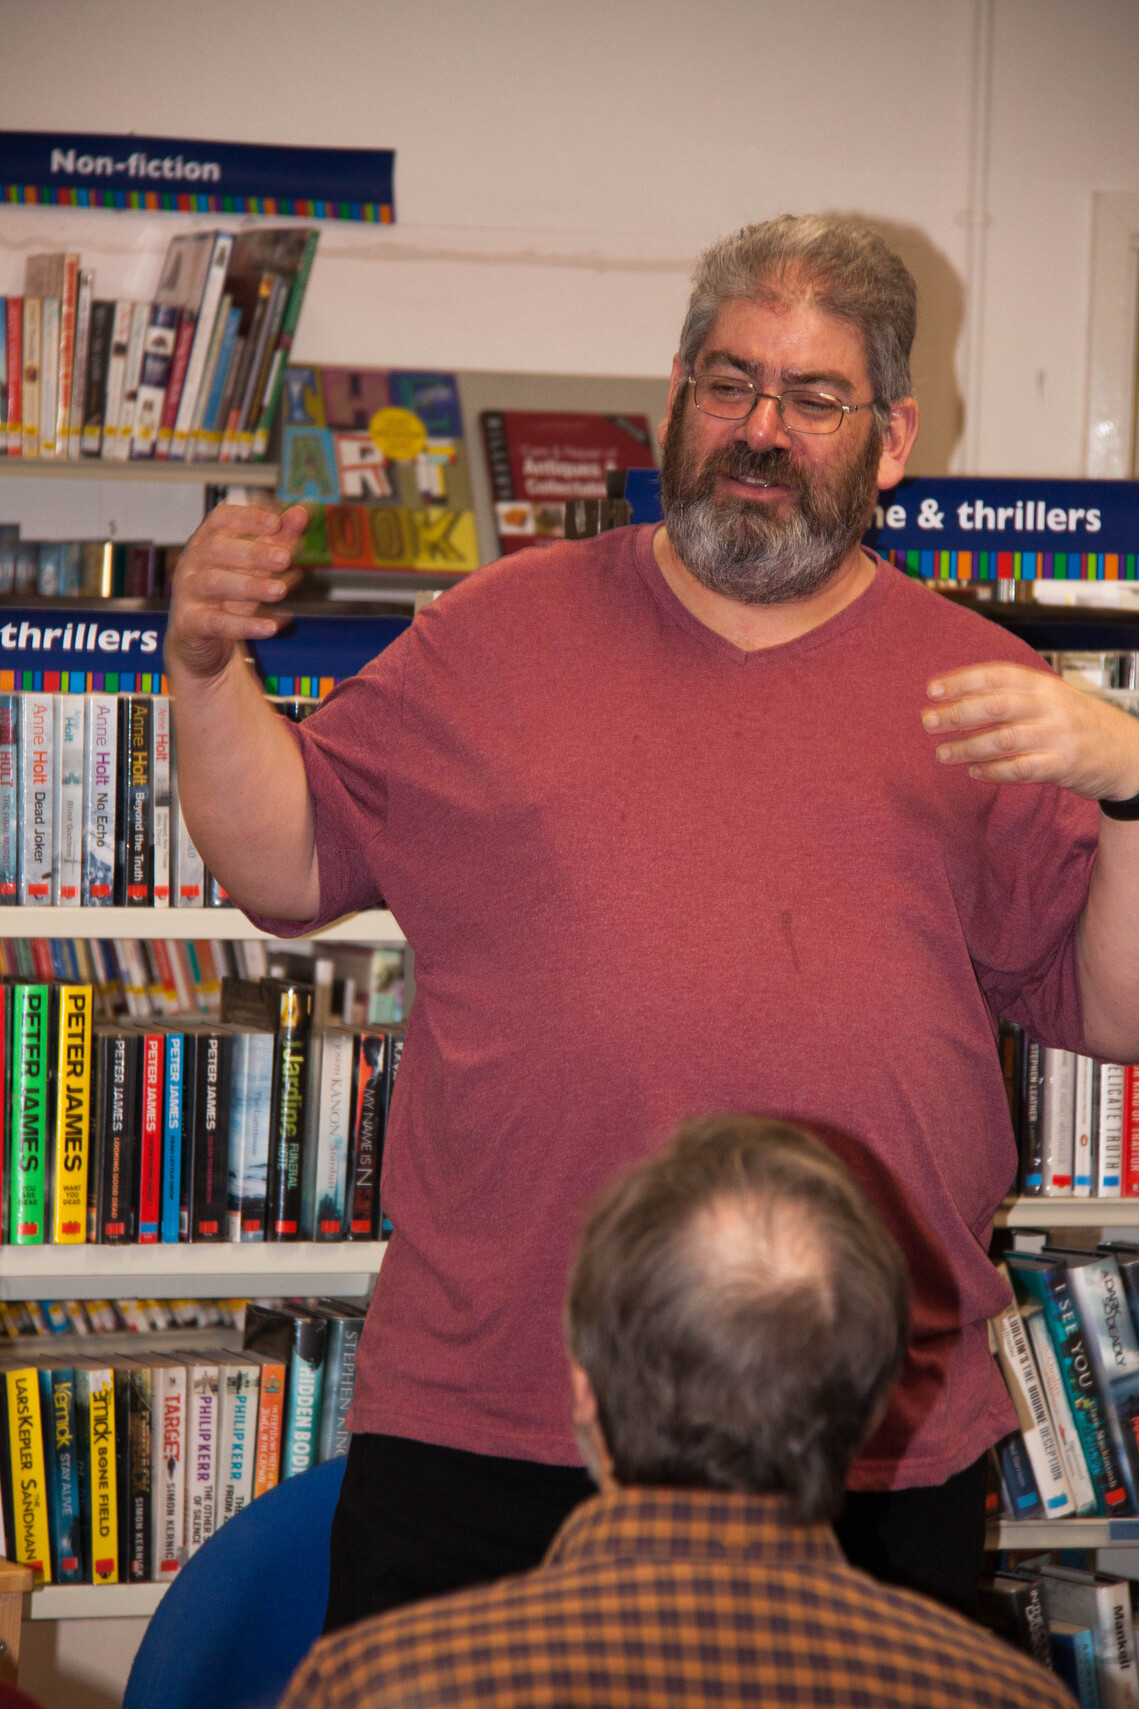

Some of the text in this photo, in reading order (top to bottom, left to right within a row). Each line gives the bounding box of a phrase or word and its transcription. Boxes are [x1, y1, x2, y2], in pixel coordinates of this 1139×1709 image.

[51, 148, 221, 182] Non-fiction
[917, 498, 945, 530] &
[957, 499, 1102, 533] thrillers
[0, 621, 158, 653] thrillers
[33, 704, 48, 785] Anne Holt
[64, 717, 74, 743] Holt
[95, 704, 111, 786] Anne Holt
[132, 704, 148, 786] Anne Holt
[155, 707, 168, 763] Anne Holt
[34, 792, 46, 864] Dead Joker
[65, 824, 73, 858] Goddess
[96, 793, 108, 848] No Echo
[133, 792, 145, 882] Beyond the Truth
[64, 993, 86, 1173] PETER JAMES
[112, 1040, 125, 1132] PETER JAMES
[146, 1040, 158, 1132] PETER JAMES
[169, 1038, 181, 1129] PETER JAMES
[206, 1039, 218, 1130] PETER JAMES
[279, 1048, 304, 1137] Jardine
[1029, 1043, 1039, 1082] STEPHEN
[19, 1087, 40, 1173] JAMES
[329, 1079, 341, 1136] KANON
[355, 1088, 375, 1187] MY NAME IS N
[1028, 1085, 1038, 1122] LEATHER
[1104, 1066, 1123, 1170] ELICATE TRUTH
[63, 1198, 81, 1206] DEAD
[287, 1143, 299, 1190] FUNERAL
[328, 1144, 339, 1189] Stardust
[338, 1330, 358, 1410] STEPHEN
[1059, 1299, 1078, 1336] SEE
[1069, 1339, 1094, 1389] YOU
[1105, 1315, 1127, 1367] DEADLY
[15, 1378, 34, 1471] LARS KEPLER
[54, 1382, 74, 1450] Kernick
[92, 1389, 112, 1445] ernick
[163, 1393, 181, 1462] TARGET
[197, 1396, 212, 1482] PHILIP KERR
[230, 1395, 247, 1480] PHILIP KERR
[290, 1367, 315, 1477] HIDDEN BODI
[1027, 1386, 1047, 1425] BOURNE
[1039, 1426, 1063, 1481] DECEPTION
[21, 1478, 37, 1561] SANDMAN
[60, 1453, 73, 1516] STAY ALIVE
[98, 1447, 110, 1538] BONE FIELD
[165, 1482, 176, 1559] SIMON KERNIC
[192, 1495, 202, 1545] OF SILENCE
[203, 1504, 213, 1533] OTHER
[204, 1485, 213, 1502] THE
[224, 1484, 234, 1513] FROM
[134, 1497, 144, 1577] SIMON KERNICK
[1113, 1604, 1131, 1671] Mankell
